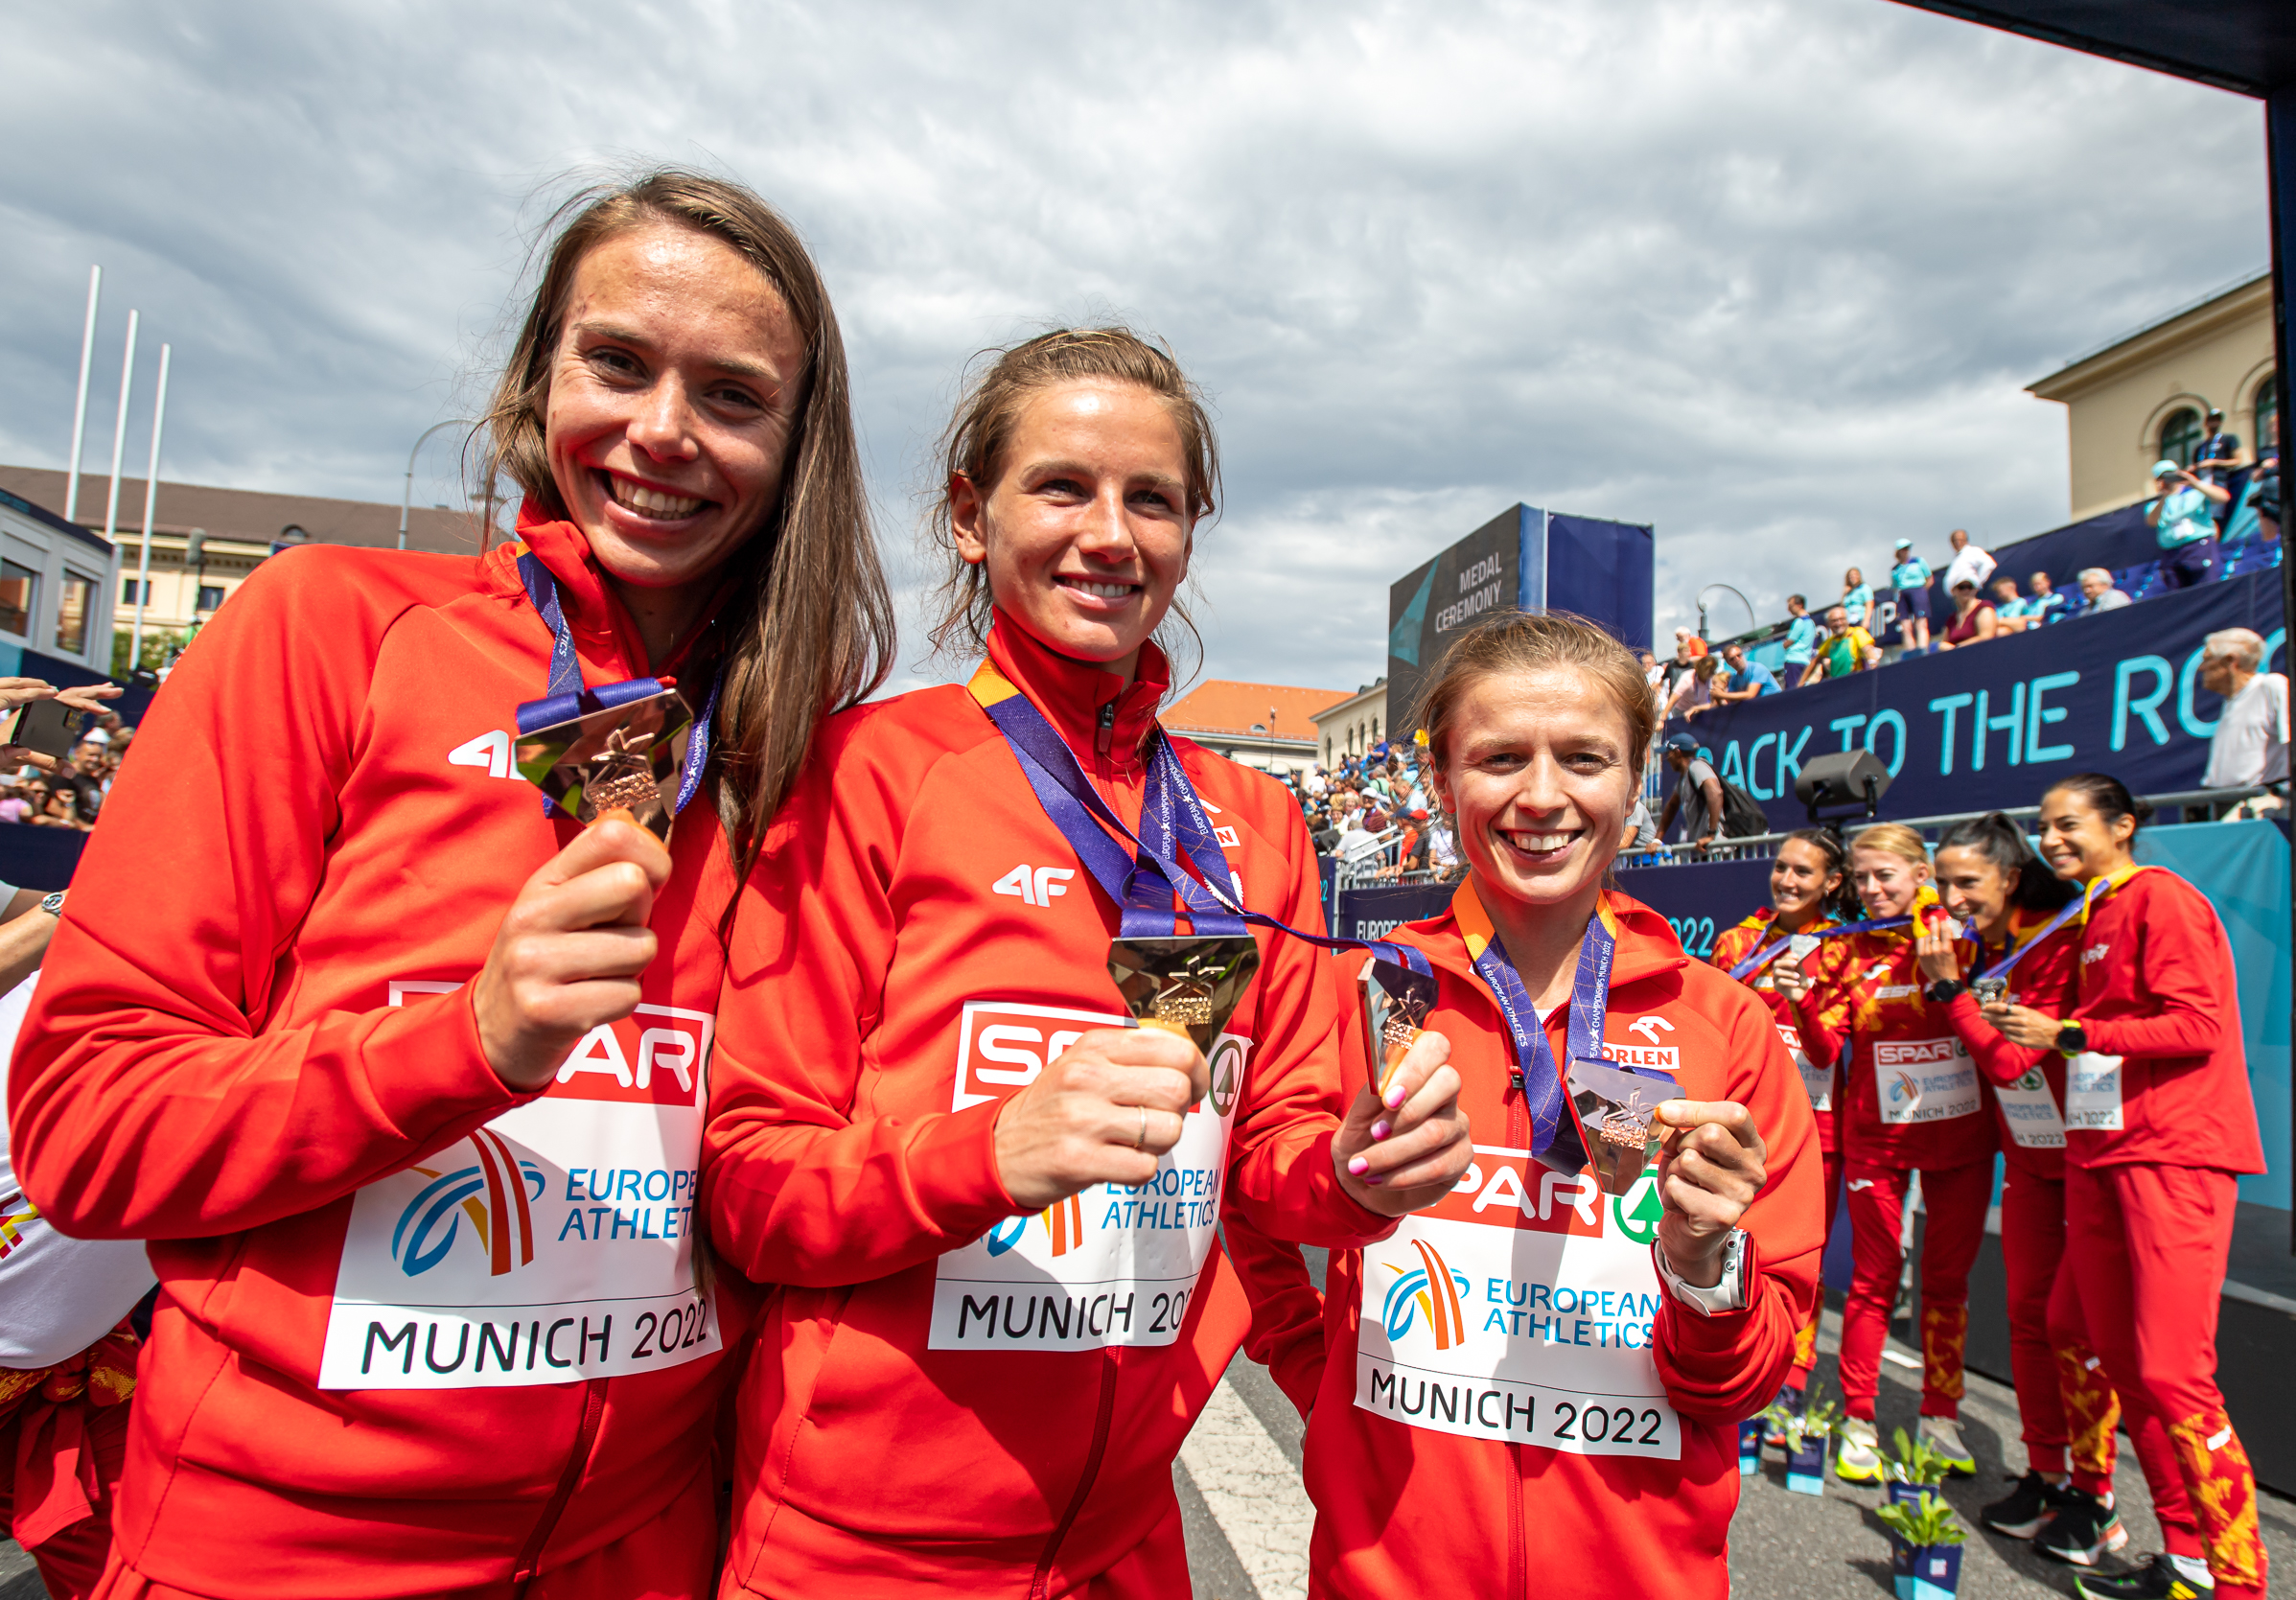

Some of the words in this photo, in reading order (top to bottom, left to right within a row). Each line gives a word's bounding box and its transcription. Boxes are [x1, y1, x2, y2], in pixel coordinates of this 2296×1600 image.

[1460, 552, 1502, 593] MEDAL
[1436, 580, 1502, 633] CEREMONY
[1696, 725, 1813, 800] ACK
[1829, 708, 1907, 778] TO
[1928, 670, 2080, 777] THE
[991, 864, 1076, 908] 4F
[1598, 954, 1609, 978] MUNICH
[1604, 940, 1612, 956] 2022
[1485, 969, 1511, 1007] EUROPEAN
[1505, 1006, 1529, 1048] ATHLETICS
[1591, 978, 1606, 1028] CHAMPIONSHIPS
[555, 1022, 696, 1093] AR
[1602, 1047, 1673, 1066] ORLEN
[1879, 1042, 1953, 1063] SPAR
[1889, 1105, 1944, 1121] MUNICH
[1949, 1100, 1978, 1115] 2022
[566, 1169, 697, 1201] EUROPE
[558, 1206, 694, 1241] ATHLET
[1102, 1198, 1216, 1230] ATHLETICS
[958, 1292, 1135, 1339] MUNICH
[1148, 1287, 1193, 1333] 20
[1487, 1278, 1661, 1318] EUROPEAN
[361, 1313, 613, 1375] MUNICH
[631, 1298, 707, 1358] 2022
[1483, 1308, 1655, 1350] ATHLETICS
[1371, 1368, 1536, 1433] MUNICH
[1553, 1401, 1662, 1446] 2022
